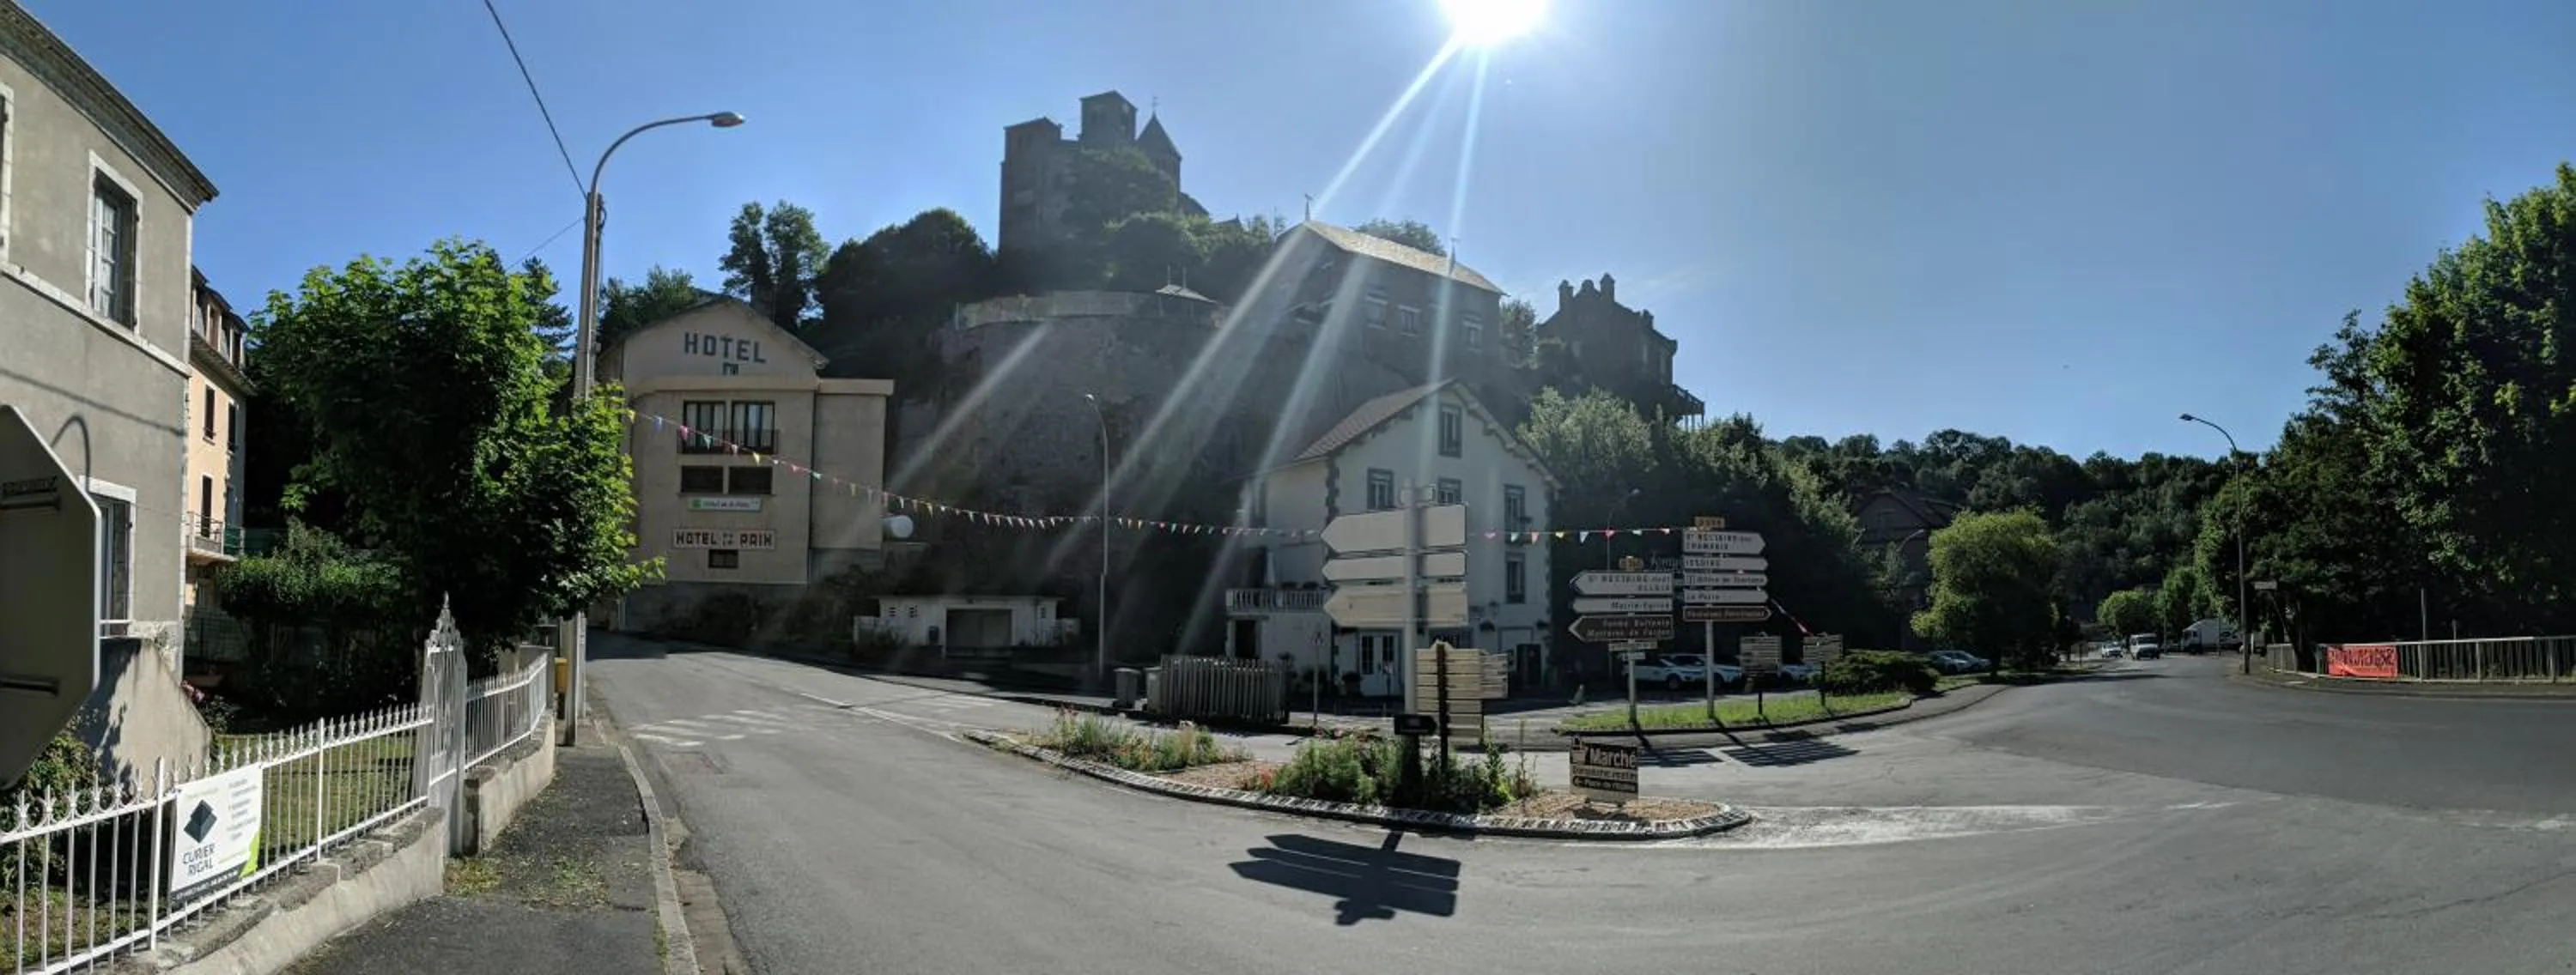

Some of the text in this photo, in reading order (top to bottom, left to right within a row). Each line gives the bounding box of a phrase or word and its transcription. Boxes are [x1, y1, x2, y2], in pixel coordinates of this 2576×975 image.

[684, 332, 768, 364] HOTEL
[676, 531, 717, 545] HOTEL
[1589, 748, 1636, 768] Marché
[188, 858, 214, 876] RIGAL
